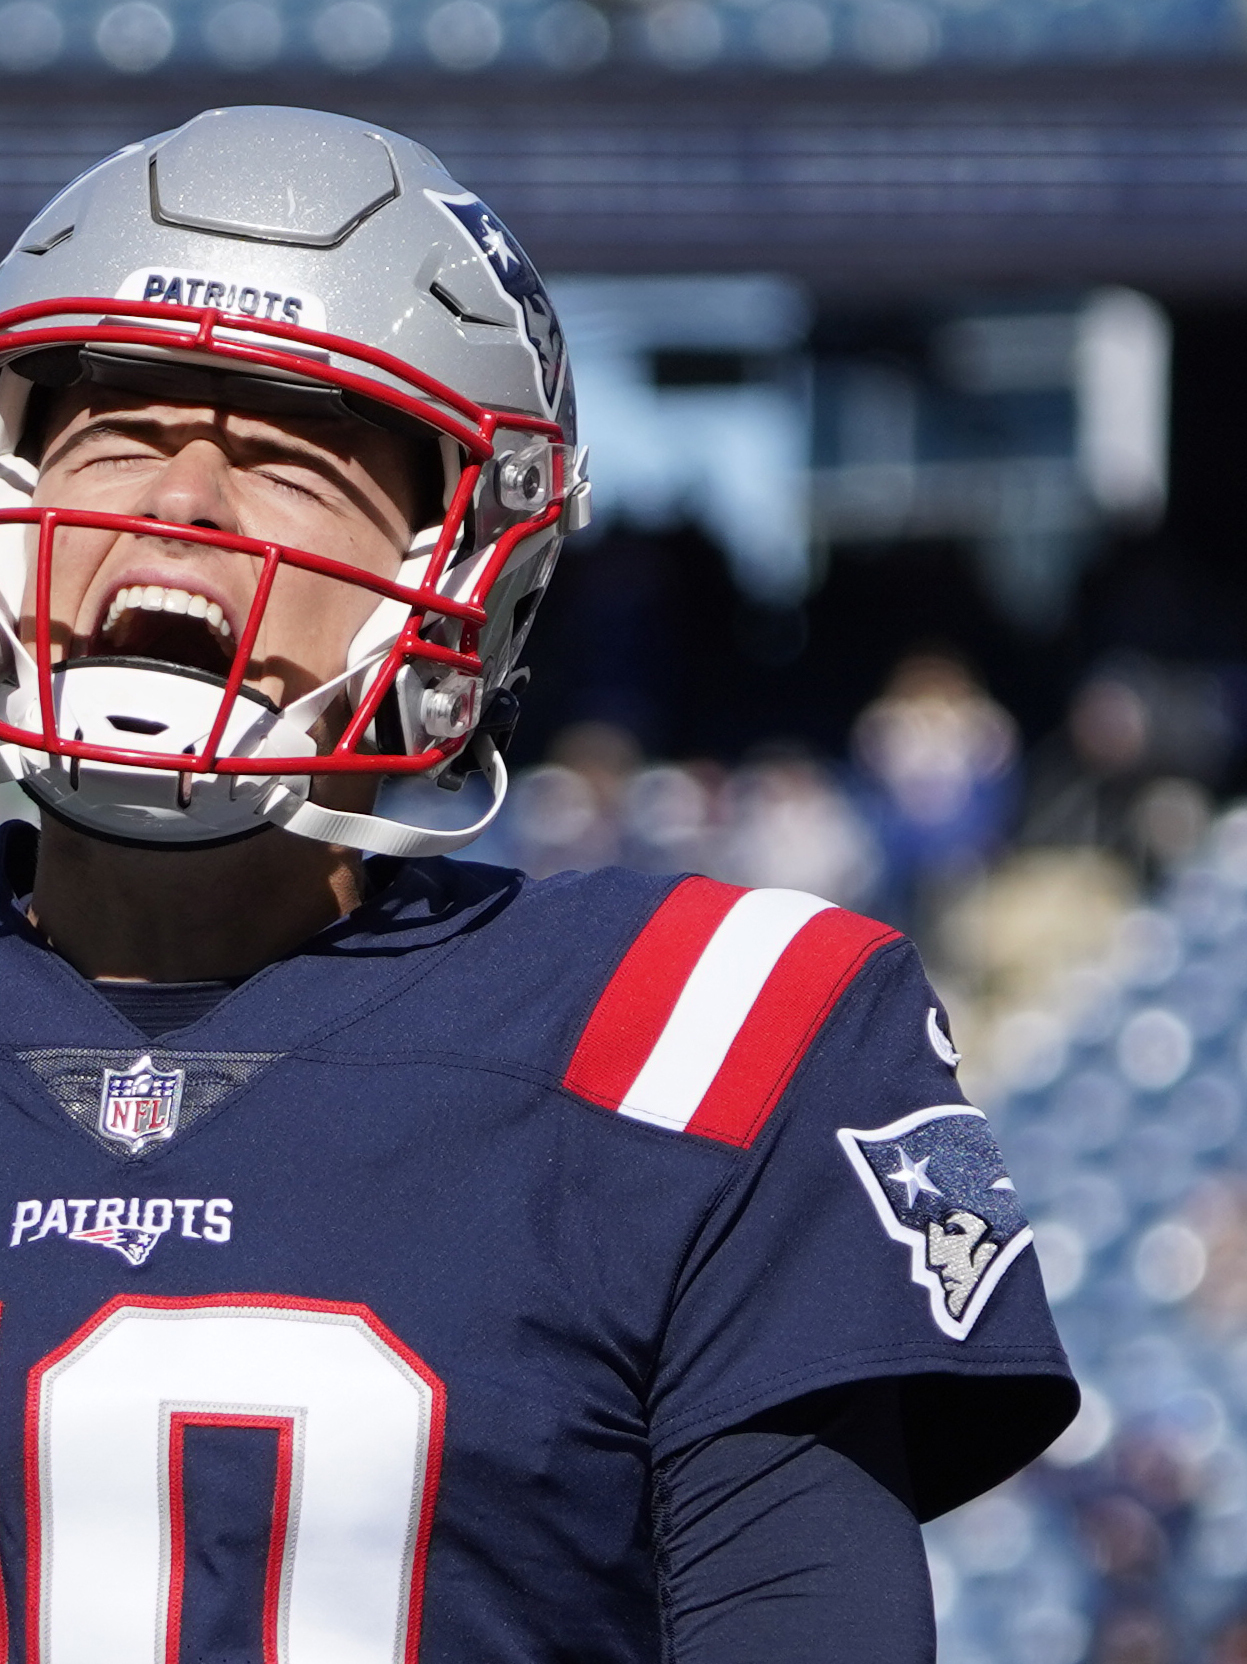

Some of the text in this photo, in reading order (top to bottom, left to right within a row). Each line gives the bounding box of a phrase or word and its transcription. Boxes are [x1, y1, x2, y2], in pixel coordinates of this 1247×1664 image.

[144, 274, 303, 325] PATRIOTS
[110, 1099, 166, 1133] NFL
[9, 1197, 234, 1248] PATRIOTS
